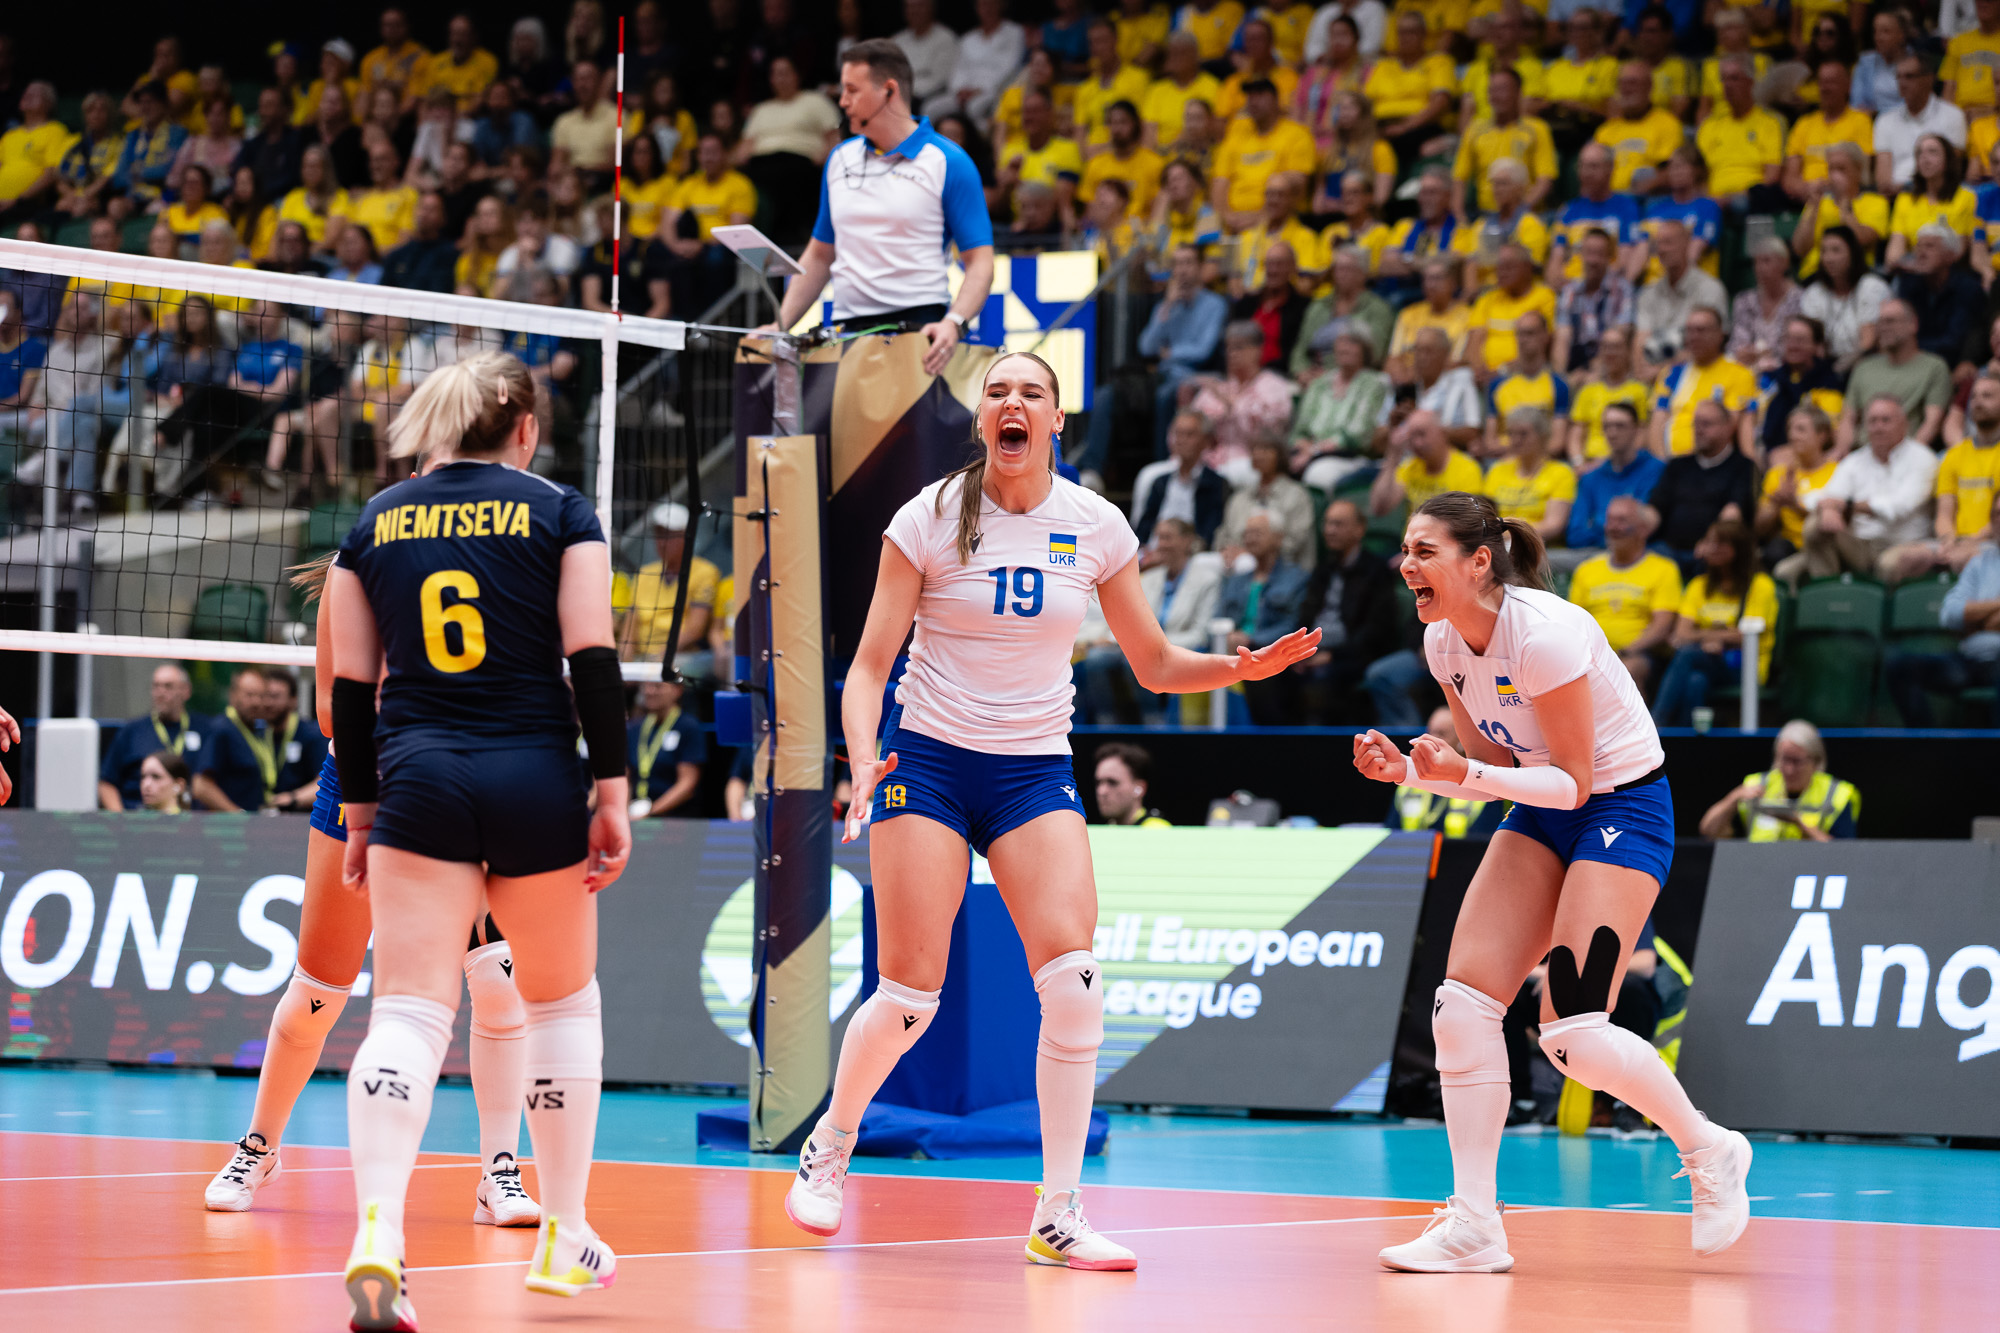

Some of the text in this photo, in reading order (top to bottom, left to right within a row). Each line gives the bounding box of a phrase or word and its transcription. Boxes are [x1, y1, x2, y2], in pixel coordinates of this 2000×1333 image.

[374, 500, 531, 547] NIEMTSEVA
[1049, 554, 1076, 567] UKR
[988, 566, 1044, 618] 19
[420, 569, 487, 674] 6
[1499, 695, 1523, 707] UKR
[884, 784, 907, 809] 19
[0, 869, 374, 996] ON.S
[1092, 913, 1385, 977] all European
[1102, 980, 1263, 1030] eague
